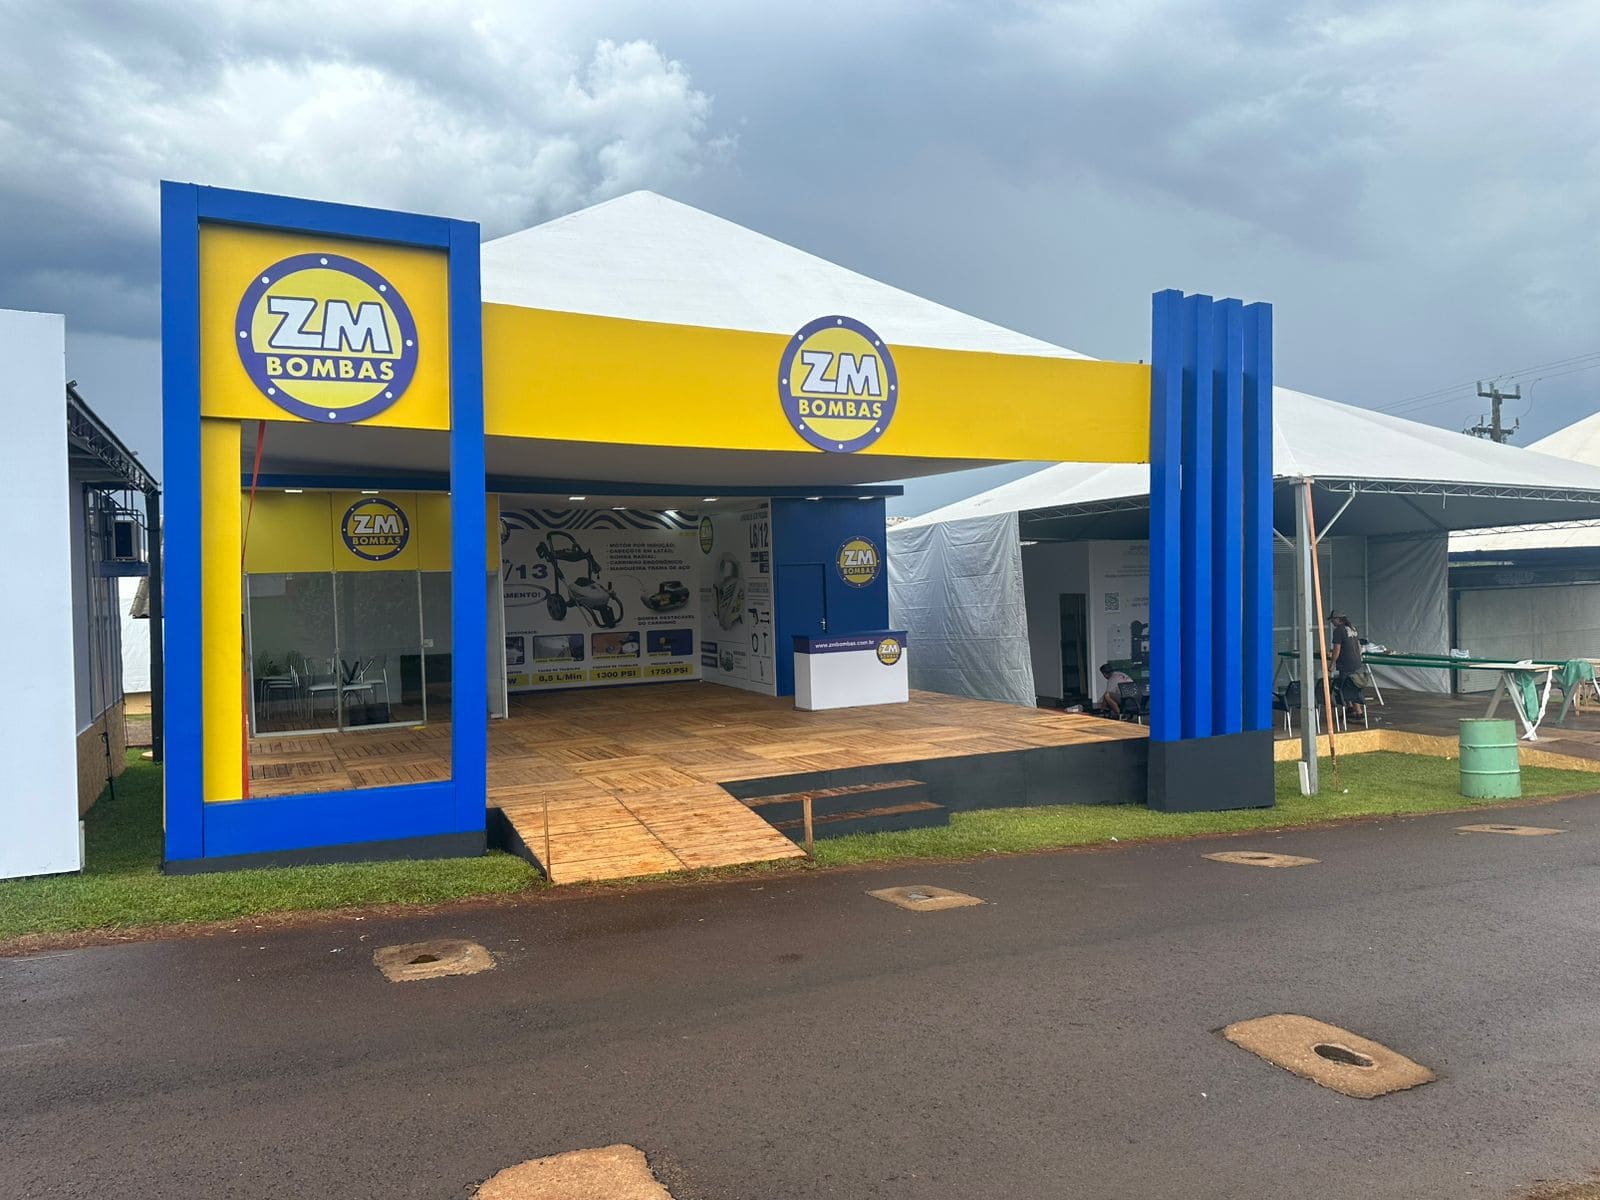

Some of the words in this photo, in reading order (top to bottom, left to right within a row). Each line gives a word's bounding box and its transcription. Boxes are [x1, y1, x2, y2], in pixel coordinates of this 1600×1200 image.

[267, 295, 393, 354] ZM
[266, 357, 395, 380] BOMBAS
[801, 350, 882, 397] ZM
[799, 400, 882, 418] BOMBAS
[353, 514, 400, 534] ZM
[352, 536, 401, 545] BOMBAS
[844, 549, 874, 566] ZM
[843, 567, 875, 575] BOMBAS
[814, 639, 875, 649] www.zmbombas.com.br
[881, 644, 898, 653] ZM
[651, 667, 672, 675] 1750
